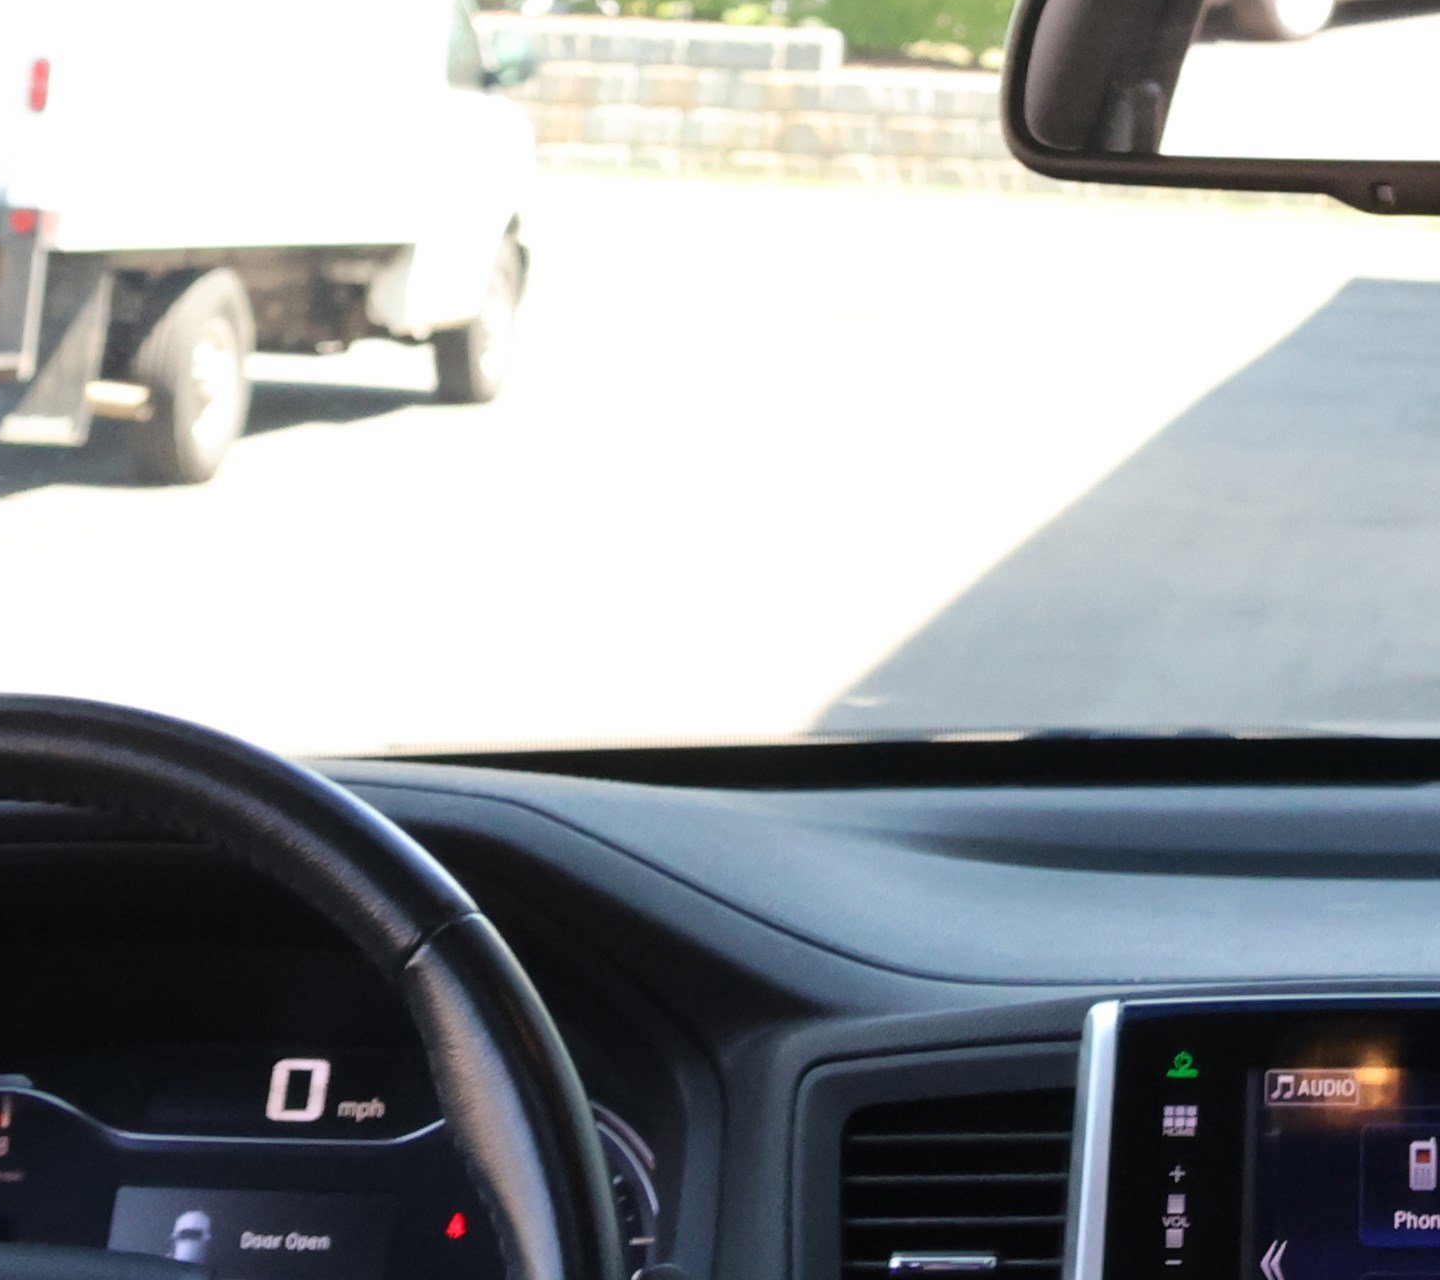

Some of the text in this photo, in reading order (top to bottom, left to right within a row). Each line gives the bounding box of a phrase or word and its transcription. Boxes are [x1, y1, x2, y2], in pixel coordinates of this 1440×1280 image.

[265, 1058, 386, 1122] 0 mph
[1297, 1077, 1356, 1099] AUDIO
[1162, 1215, 1192, 1229] VOL
[239, 1230, 332, 1252] Door Open
